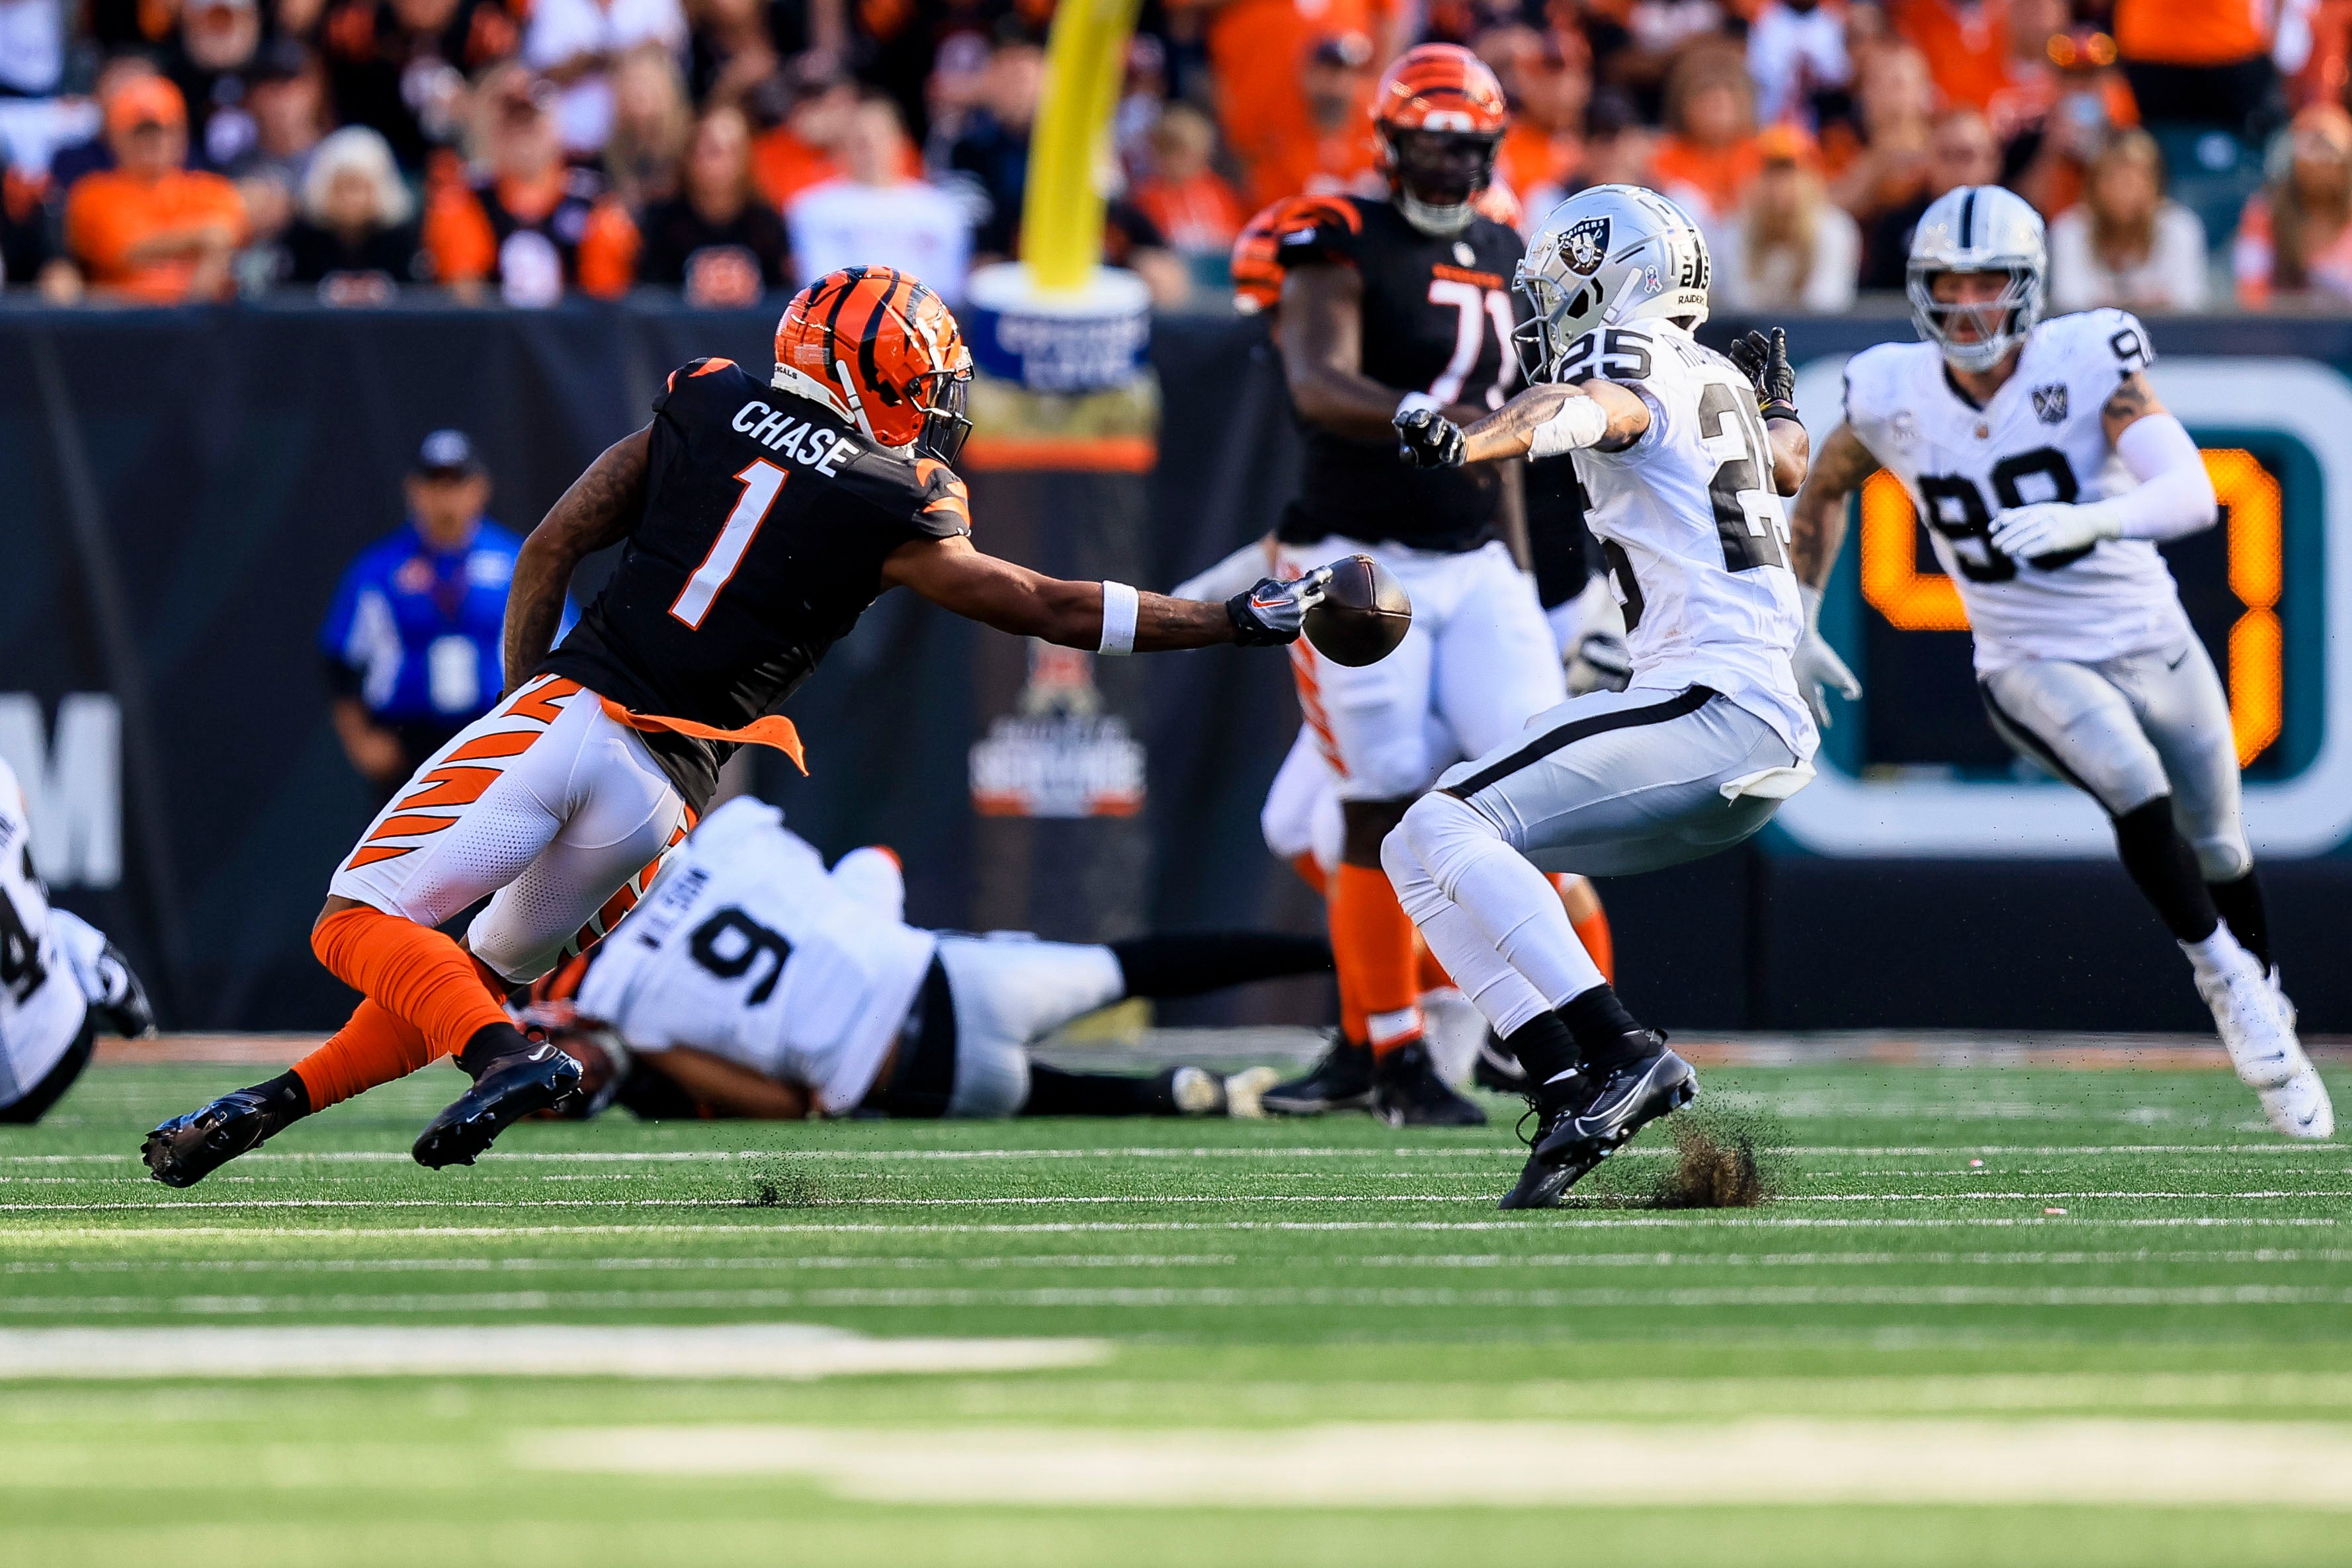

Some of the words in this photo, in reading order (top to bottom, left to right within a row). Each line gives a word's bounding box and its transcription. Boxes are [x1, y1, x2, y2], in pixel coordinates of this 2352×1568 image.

[1560, 220, 1605, 240] RAIDERS
[1427, 278, 1521, 411] 71
[1557, 329, 1653, 384] 25
[732, 401, 860, 478] CHASE
[667, 457, 789, 630] 1
[689, 903, 794, 1007] 9
